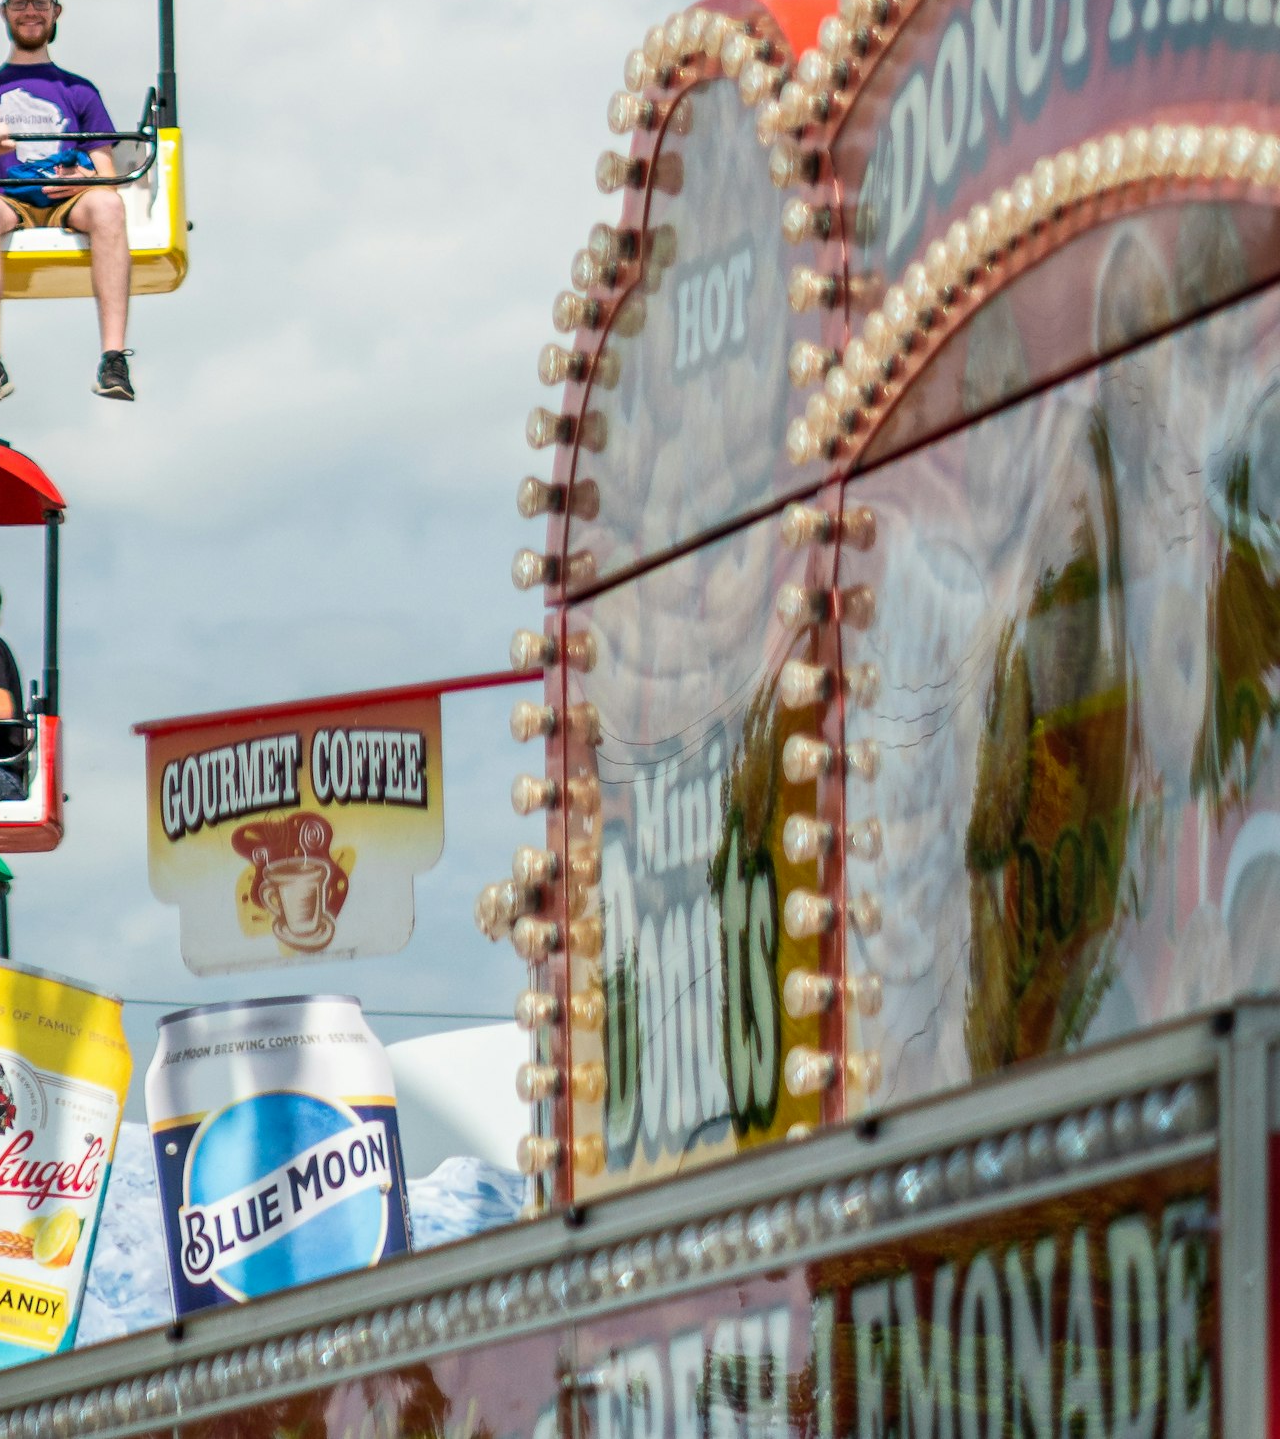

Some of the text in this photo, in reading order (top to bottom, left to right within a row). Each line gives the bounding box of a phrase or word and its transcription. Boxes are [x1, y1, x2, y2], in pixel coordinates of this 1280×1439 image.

[674, 247, 752, 371] HOT
[161, 728, 427, 840] GOURMET COFFEE
[633, 741, 724, 875] Mini
[13, 1009, 31, 1022] OF
[214, 1038, 265, 1056] BREWING
[268, 1034, 320, 1049] COMPANY
[184, 1128, 389, 1278] BLUE MOON
